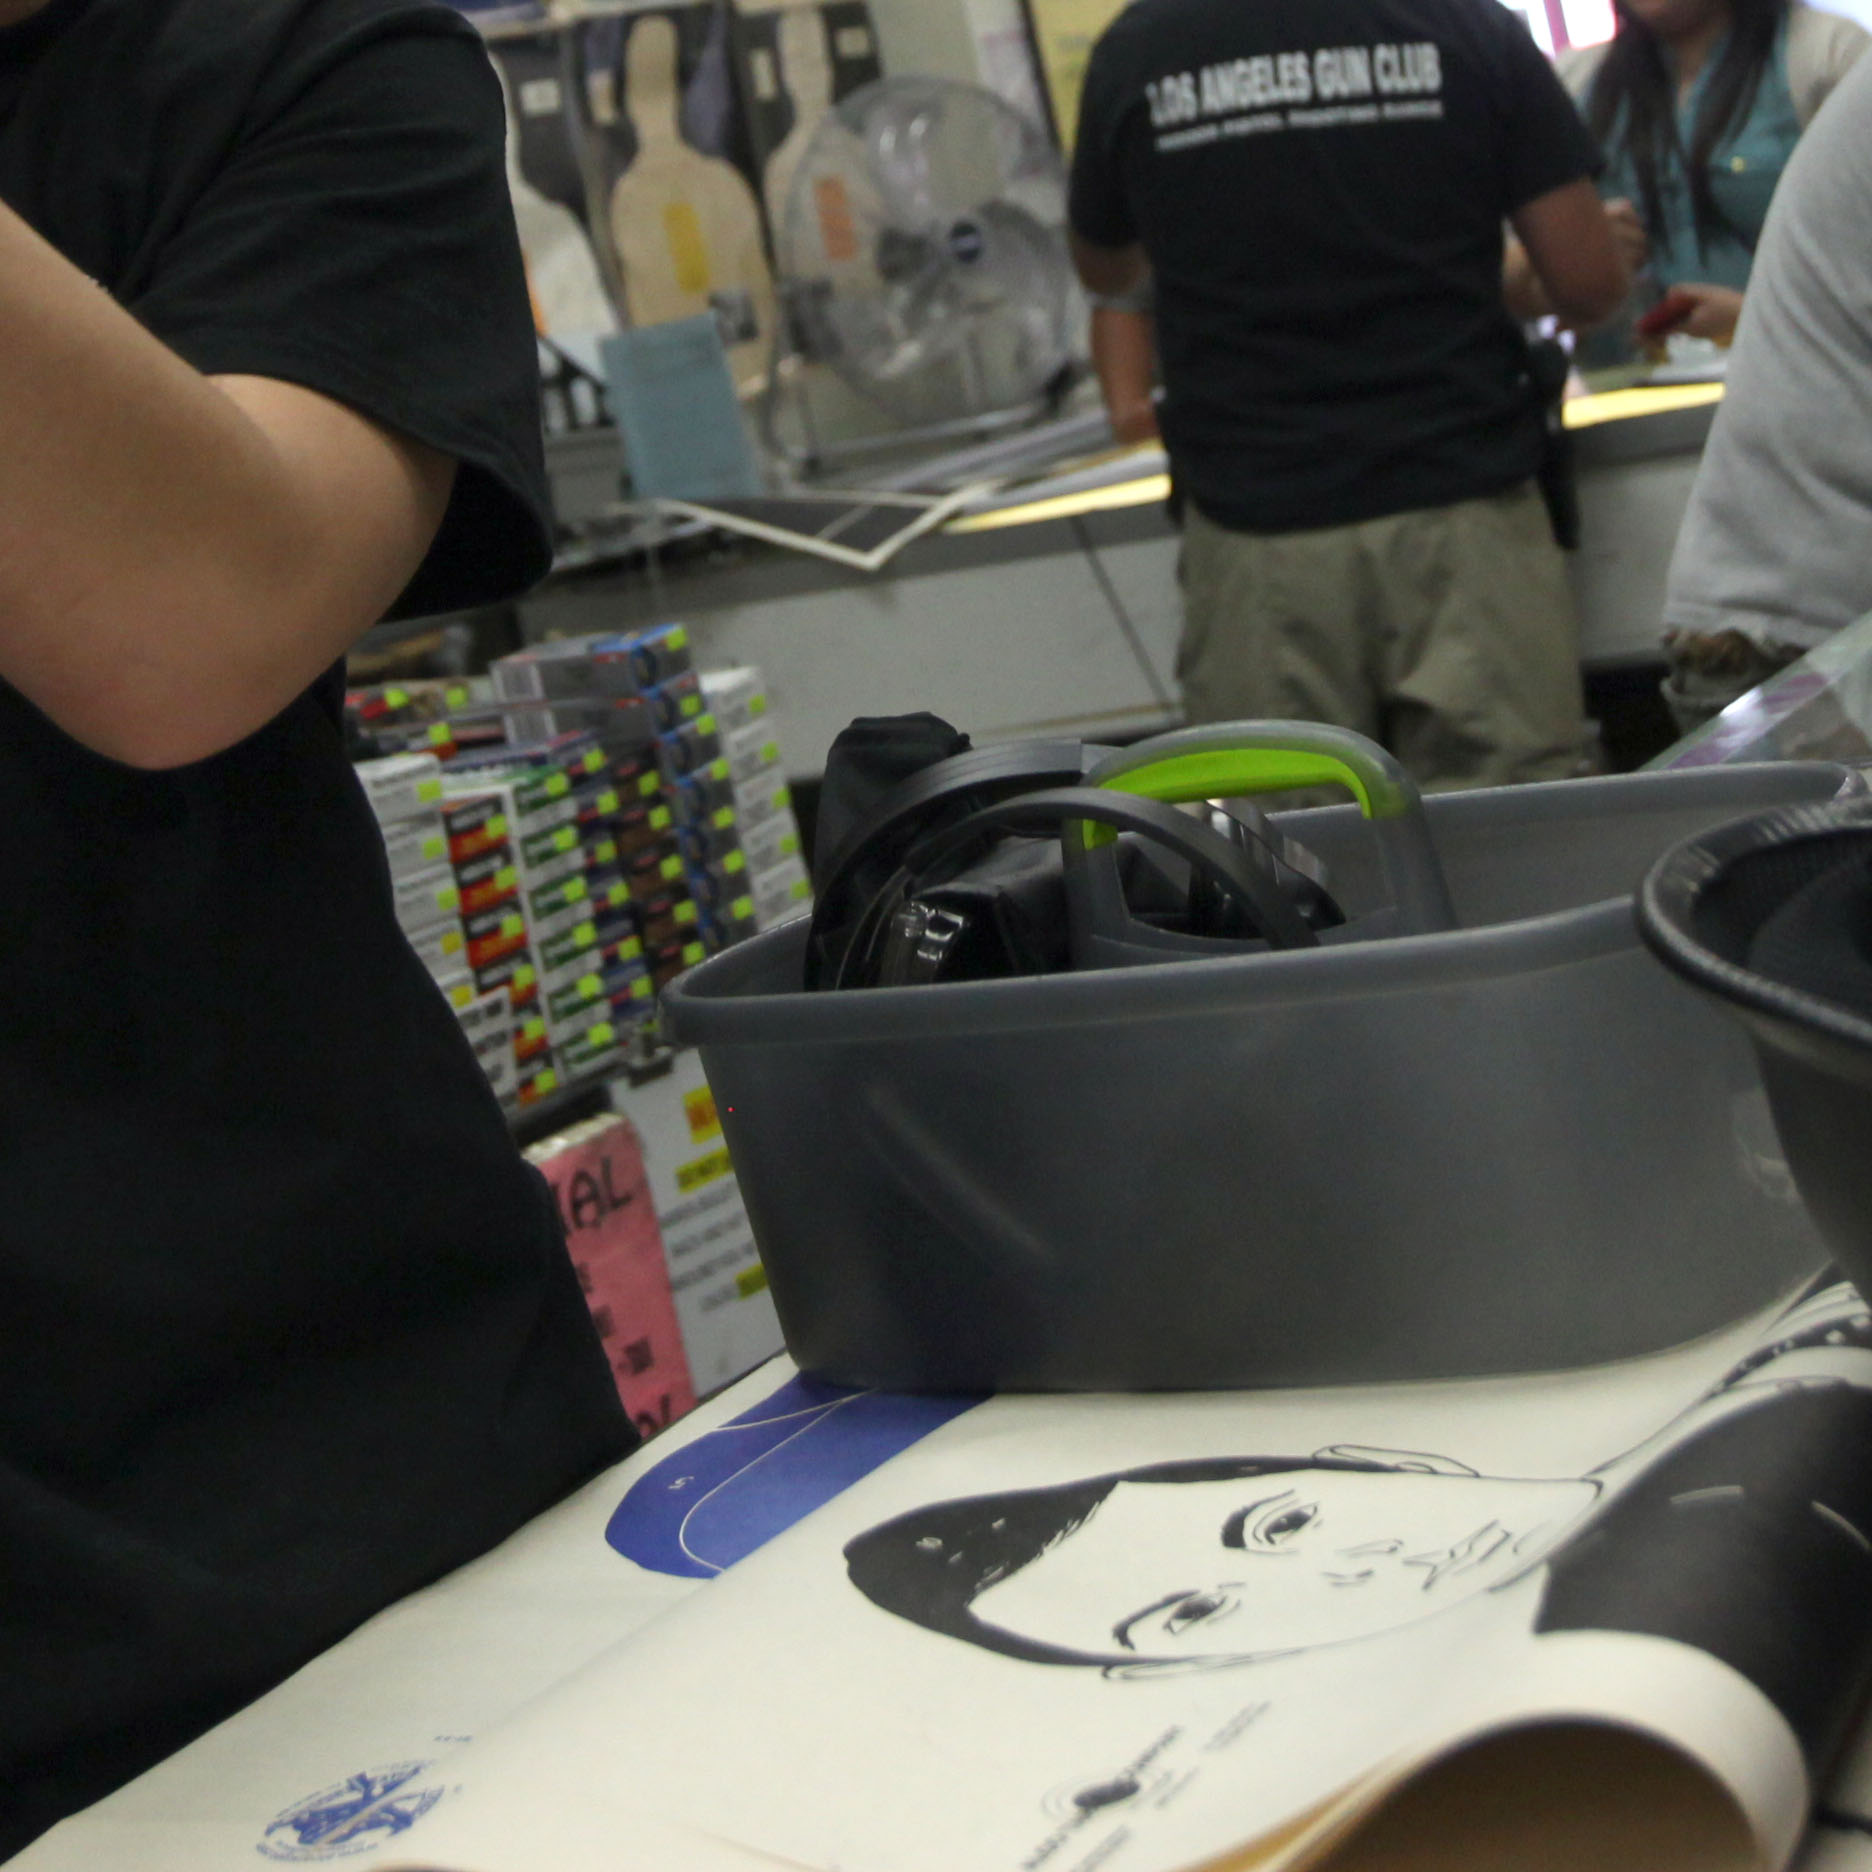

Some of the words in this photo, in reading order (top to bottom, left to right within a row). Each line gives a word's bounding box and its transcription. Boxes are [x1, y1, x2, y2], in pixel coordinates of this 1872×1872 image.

[1145, 71, 1197, 127] LOS
[1200, 51, 1312, 114] ANGELES
[1314, 46, 1372, 101] GUN
[1373, 42, 1443, 93] CLUB
